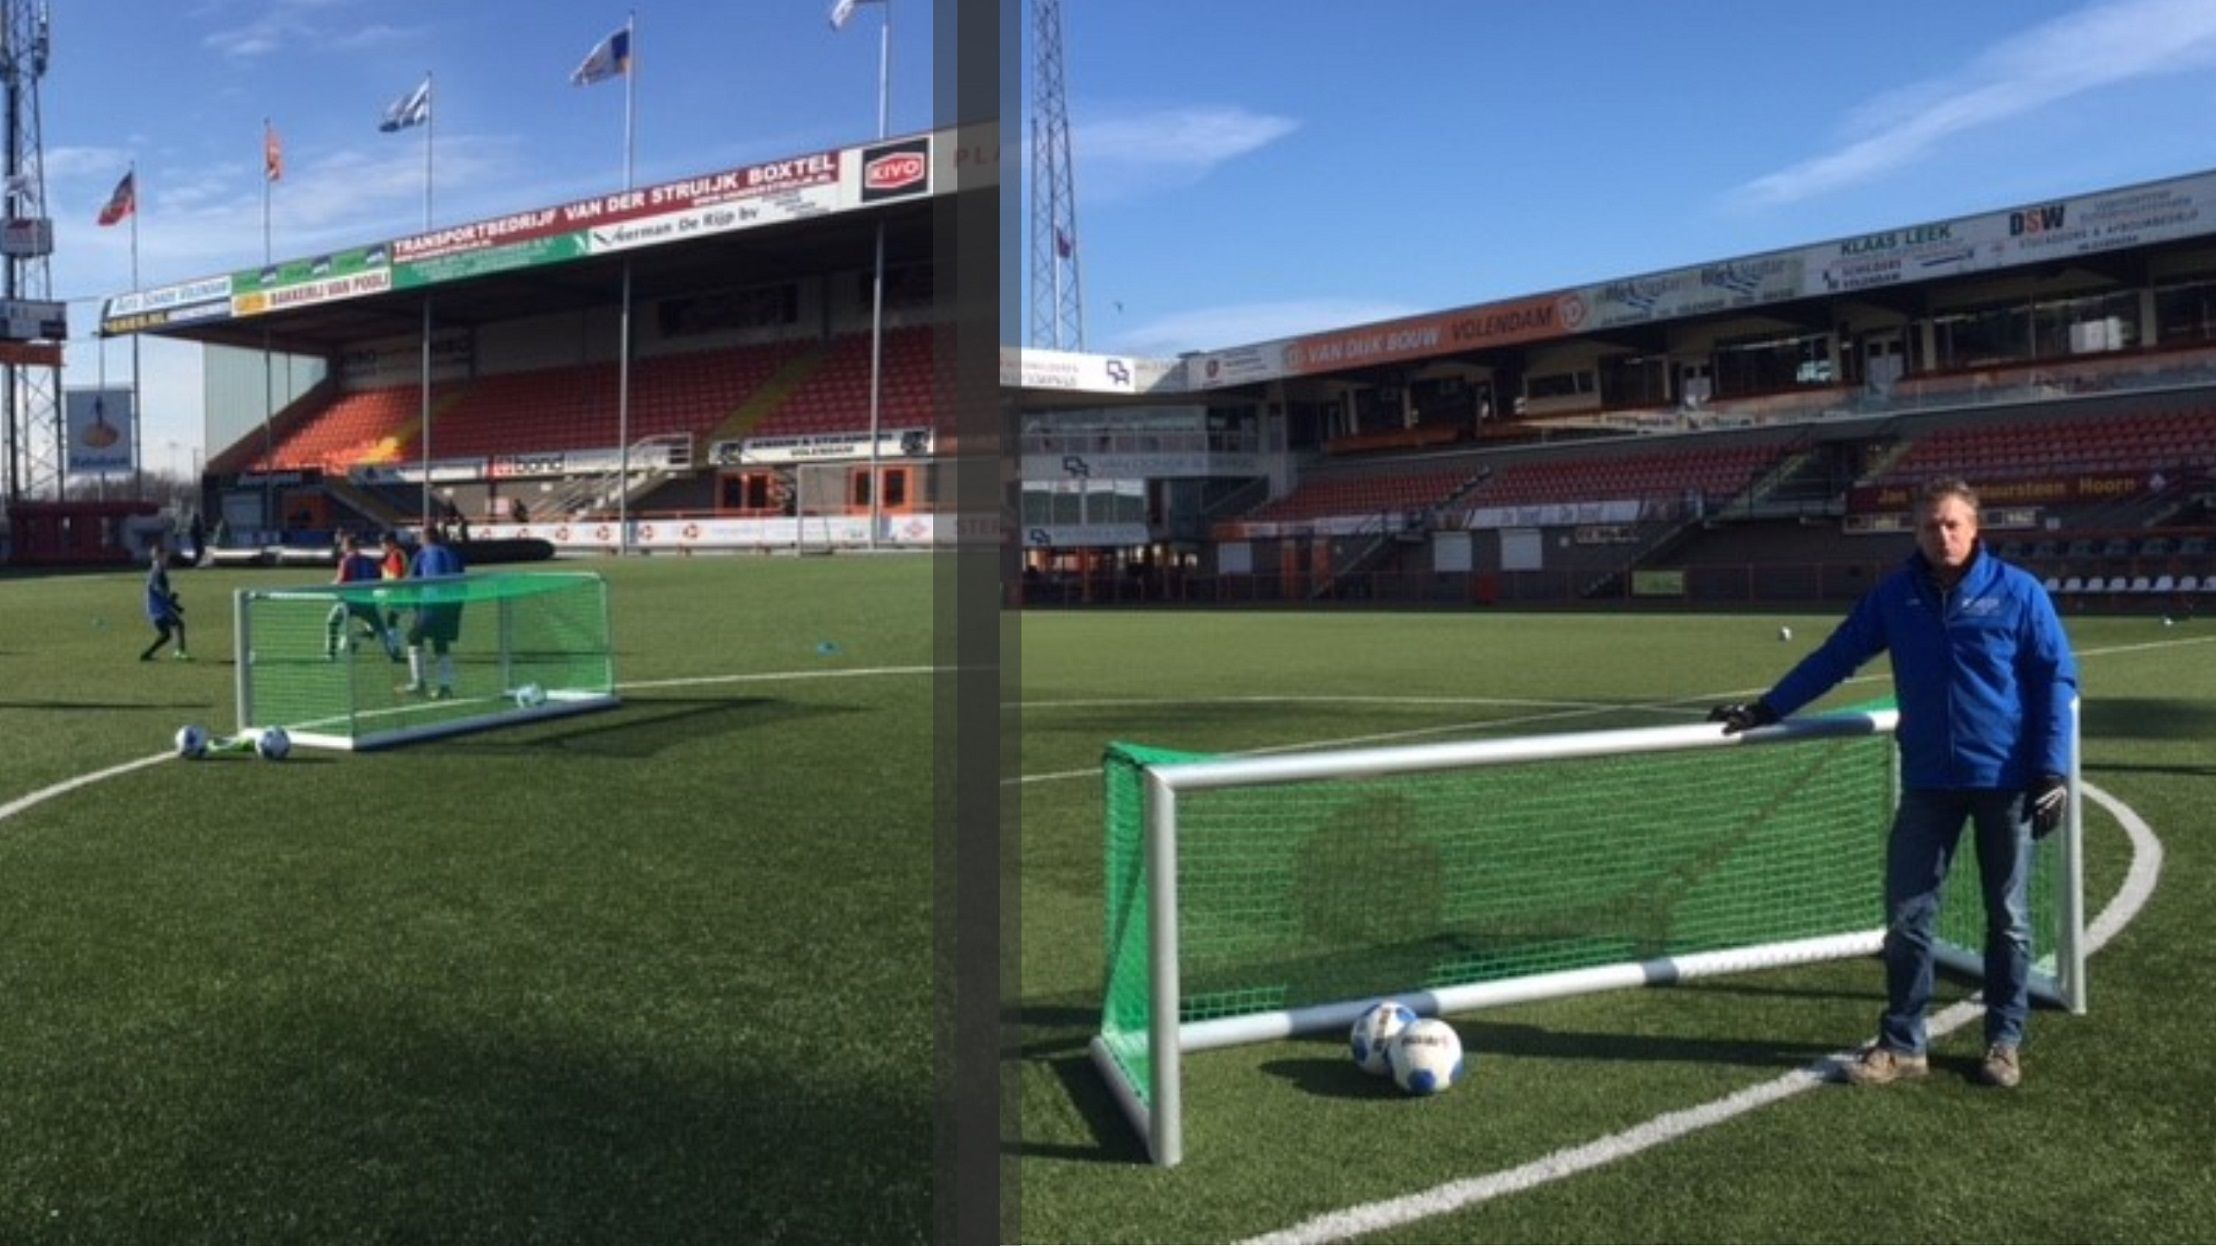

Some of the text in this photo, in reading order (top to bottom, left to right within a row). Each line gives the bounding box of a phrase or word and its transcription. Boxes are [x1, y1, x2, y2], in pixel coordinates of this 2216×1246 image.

[872, 158, 920, 181] KIVO
[394, 209, 557, 254] TRANSPORTBEDRIJF
[564, 199, 601, 221] VAN
[607, 191, 645, 213] DER
[651, 172, 739, 204] STRUIJK
[749, 153, 836, 184] BOXTEL
[2009, 203, 2065, 237] DSW
[679, 216, 699, 232] De
[1841, 222, 1951, 256] KLAAS LEEK
[1307, 342, 1342, 365] VAN
[1451, 306, 1553, 341] VOLENDAM
[2079, 476, 2137, 495] Hoorn
